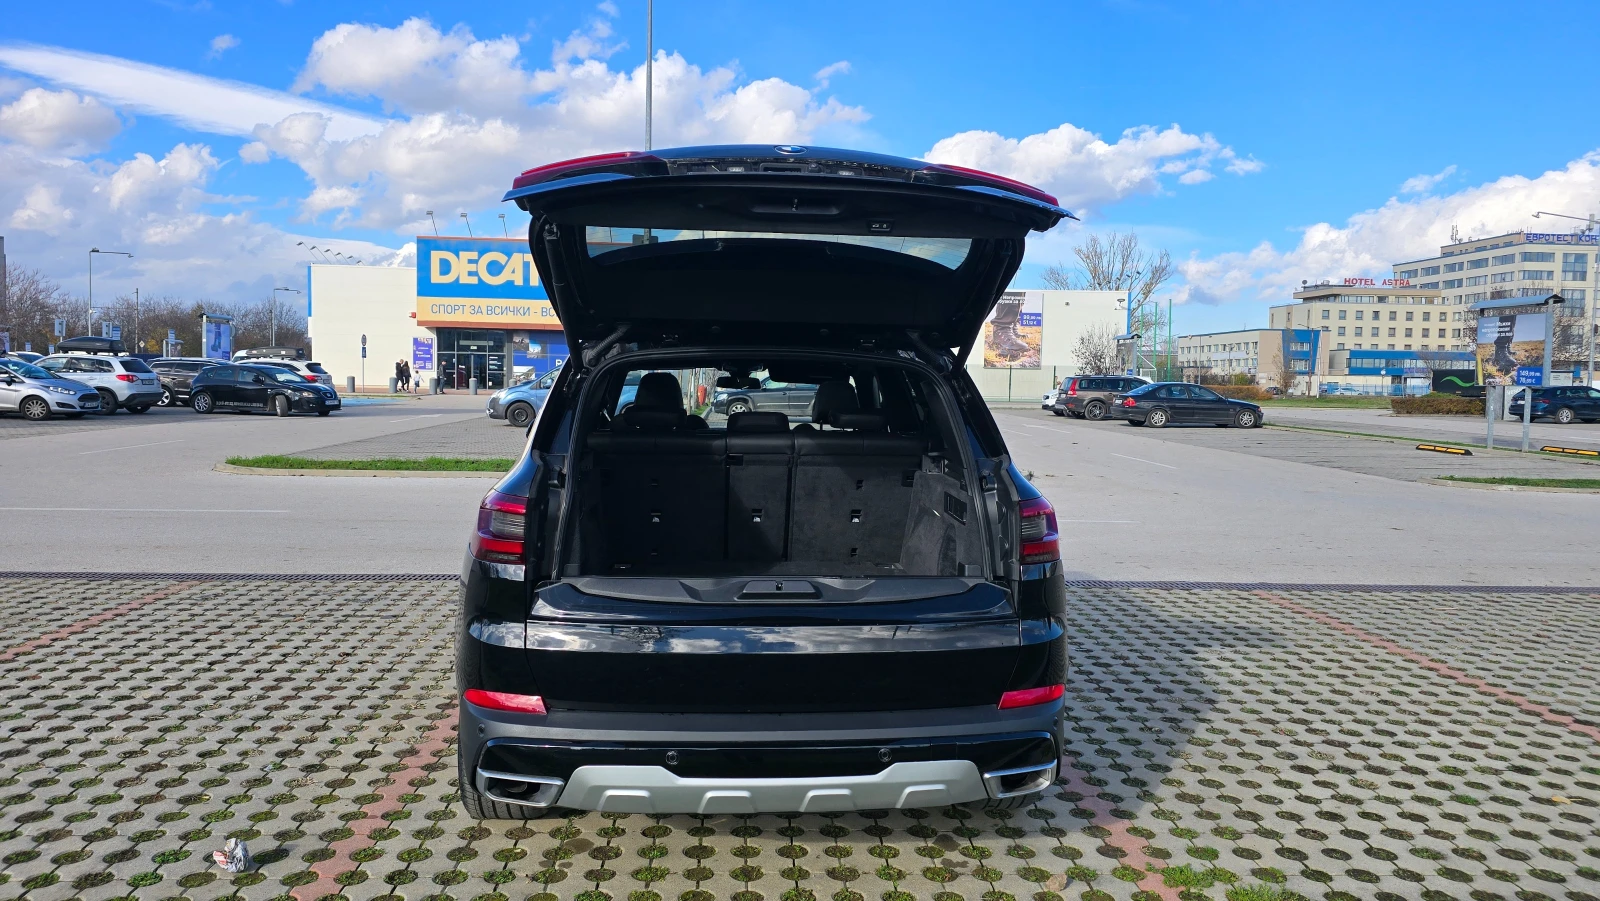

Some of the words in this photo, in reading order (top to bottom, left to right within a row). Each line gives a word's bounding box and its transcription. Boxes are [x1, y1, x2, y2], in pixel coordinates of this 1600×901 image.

[1525, 233, 1575, 242] ЕВРОТЕСТ
[430, 250, 540, 286] DECAT
[1344, 278, 1375, 286] HOTEL
[1382, 278, 1410, 286] ASTRA
[431, 303, 466, 315] СПОРТ
[469, 305, 483, 316] ЗА
[486, 305, 531, 317] ВСИЧКИ
